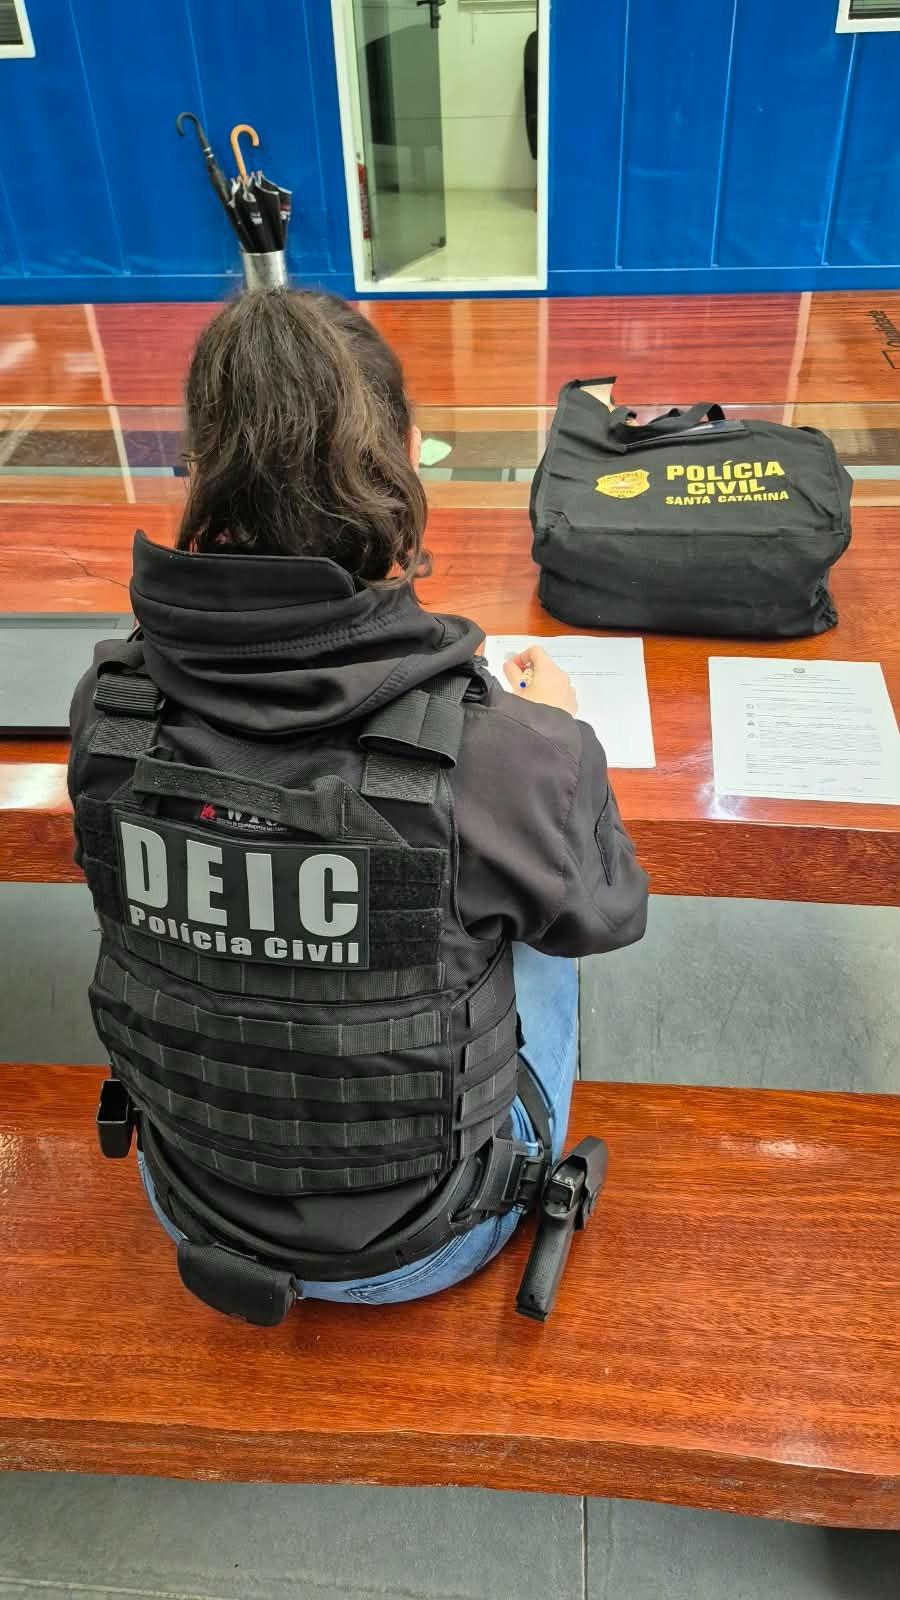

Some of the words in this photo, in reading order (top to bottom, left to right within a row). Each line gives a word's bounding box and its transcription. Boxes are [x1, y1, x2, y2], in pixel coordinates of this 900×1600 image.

[666, 461, 785, 480] POLÍCIA
[687, 480, 765, 495] CIVIL
[665, 496, 711, 505] SANTA
[717, 491, 789, 503] CATARINA
[120, 822, 359, 937] DEIC
[129, 905, 252, 956] Polícia
[264, 937, 360, 964] Civil
